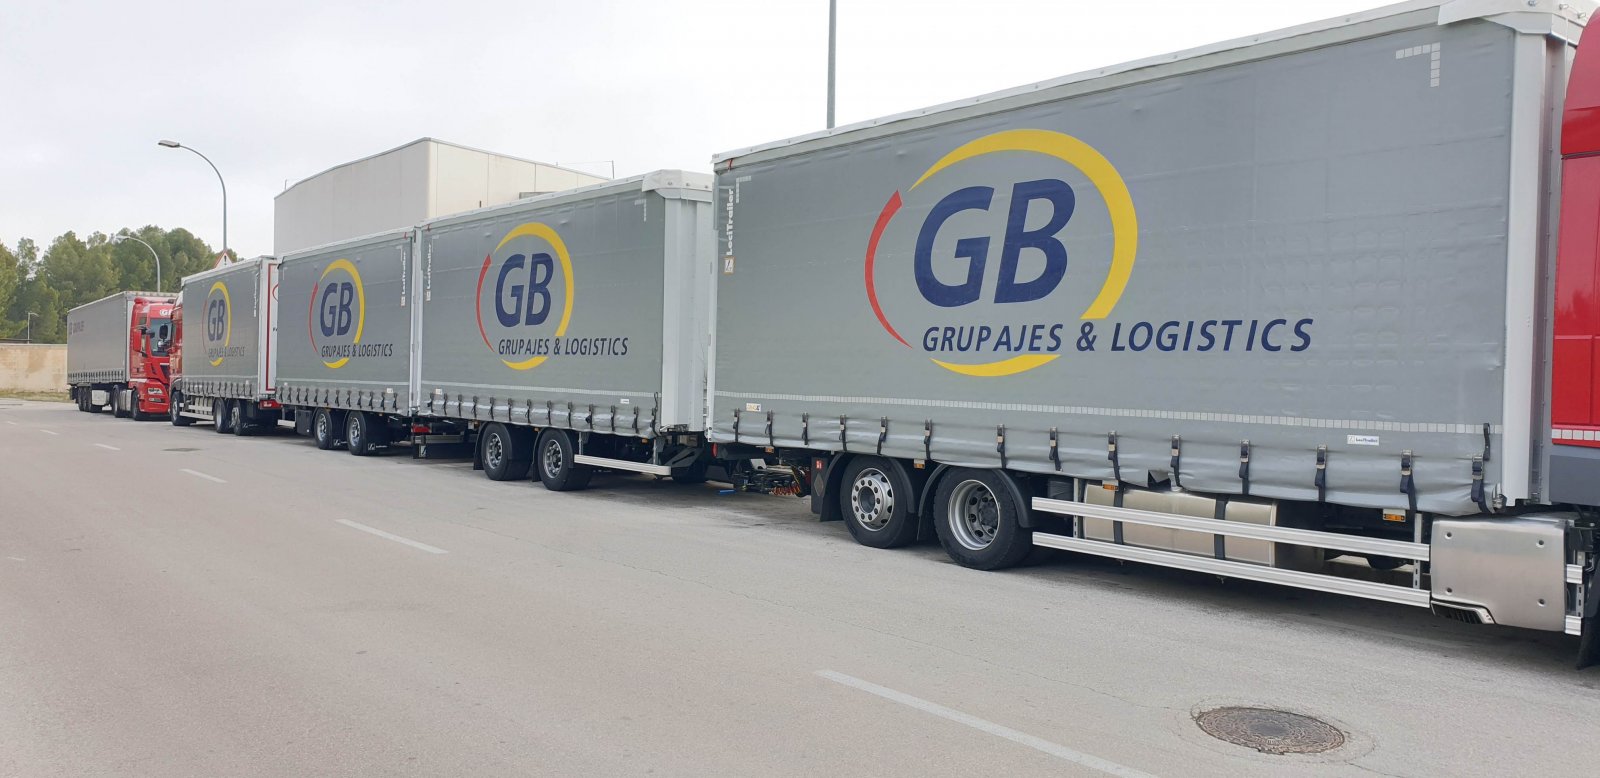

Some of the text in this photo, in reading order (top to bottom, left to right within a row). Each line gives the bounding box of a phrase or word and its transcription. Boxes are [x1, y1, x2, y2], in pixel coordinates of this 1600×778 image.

[913, 178, 1076, 308] GB
[319, 281, 354, 338] GB
[494, 252, 554, 328] GB
[207, 299, 226, 342] GB
[922, 317, 1314, 353] GRUPAJES & LOGISTICS
[321, 343, 394, 358] GRUPAJES & LOGISTICS
[498, 337, 629, 356] GRUPAJES & LOGISTICS
